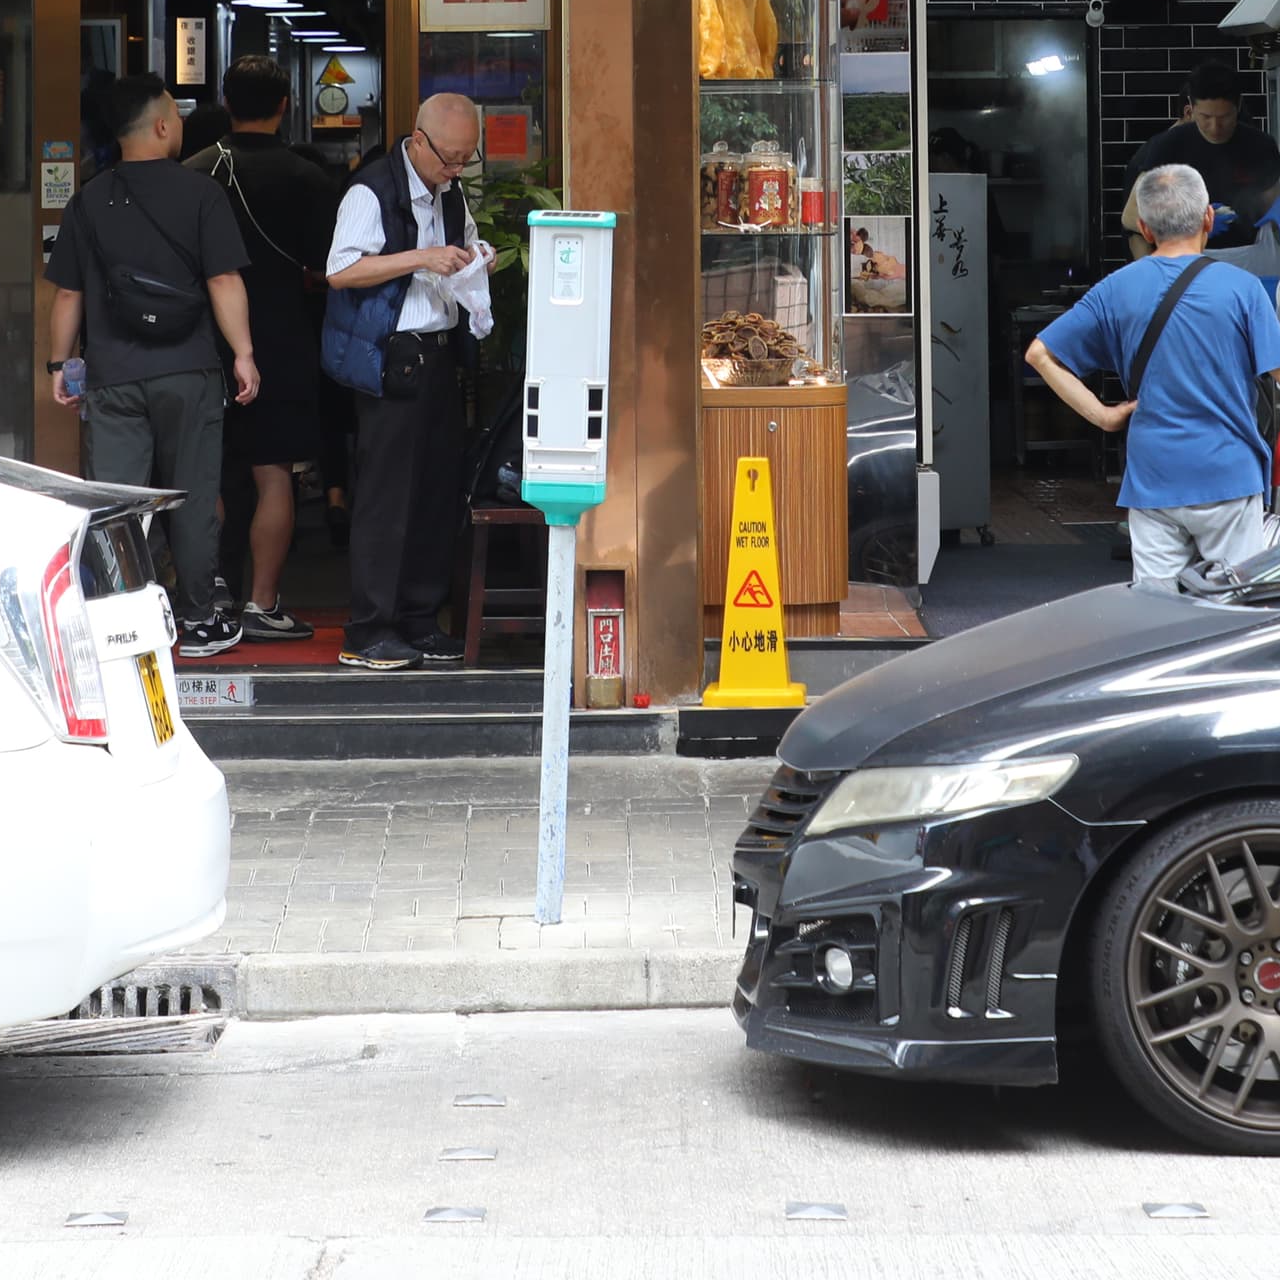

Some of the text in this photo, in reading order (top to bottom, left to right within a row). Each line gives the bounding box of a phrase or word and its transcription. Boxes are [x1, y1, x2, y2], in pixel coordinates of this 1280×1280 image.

[739, 521, 766, 533] CAUTION
[736, 536, 769, 548] WET FLOOR
[107, 630, 139, 645] PRIUS
[729, 630, 778, 653] 小心地滑
[179, 680, 217, 693] 心梯級
[185, 696, 217, 705] THE STEP
